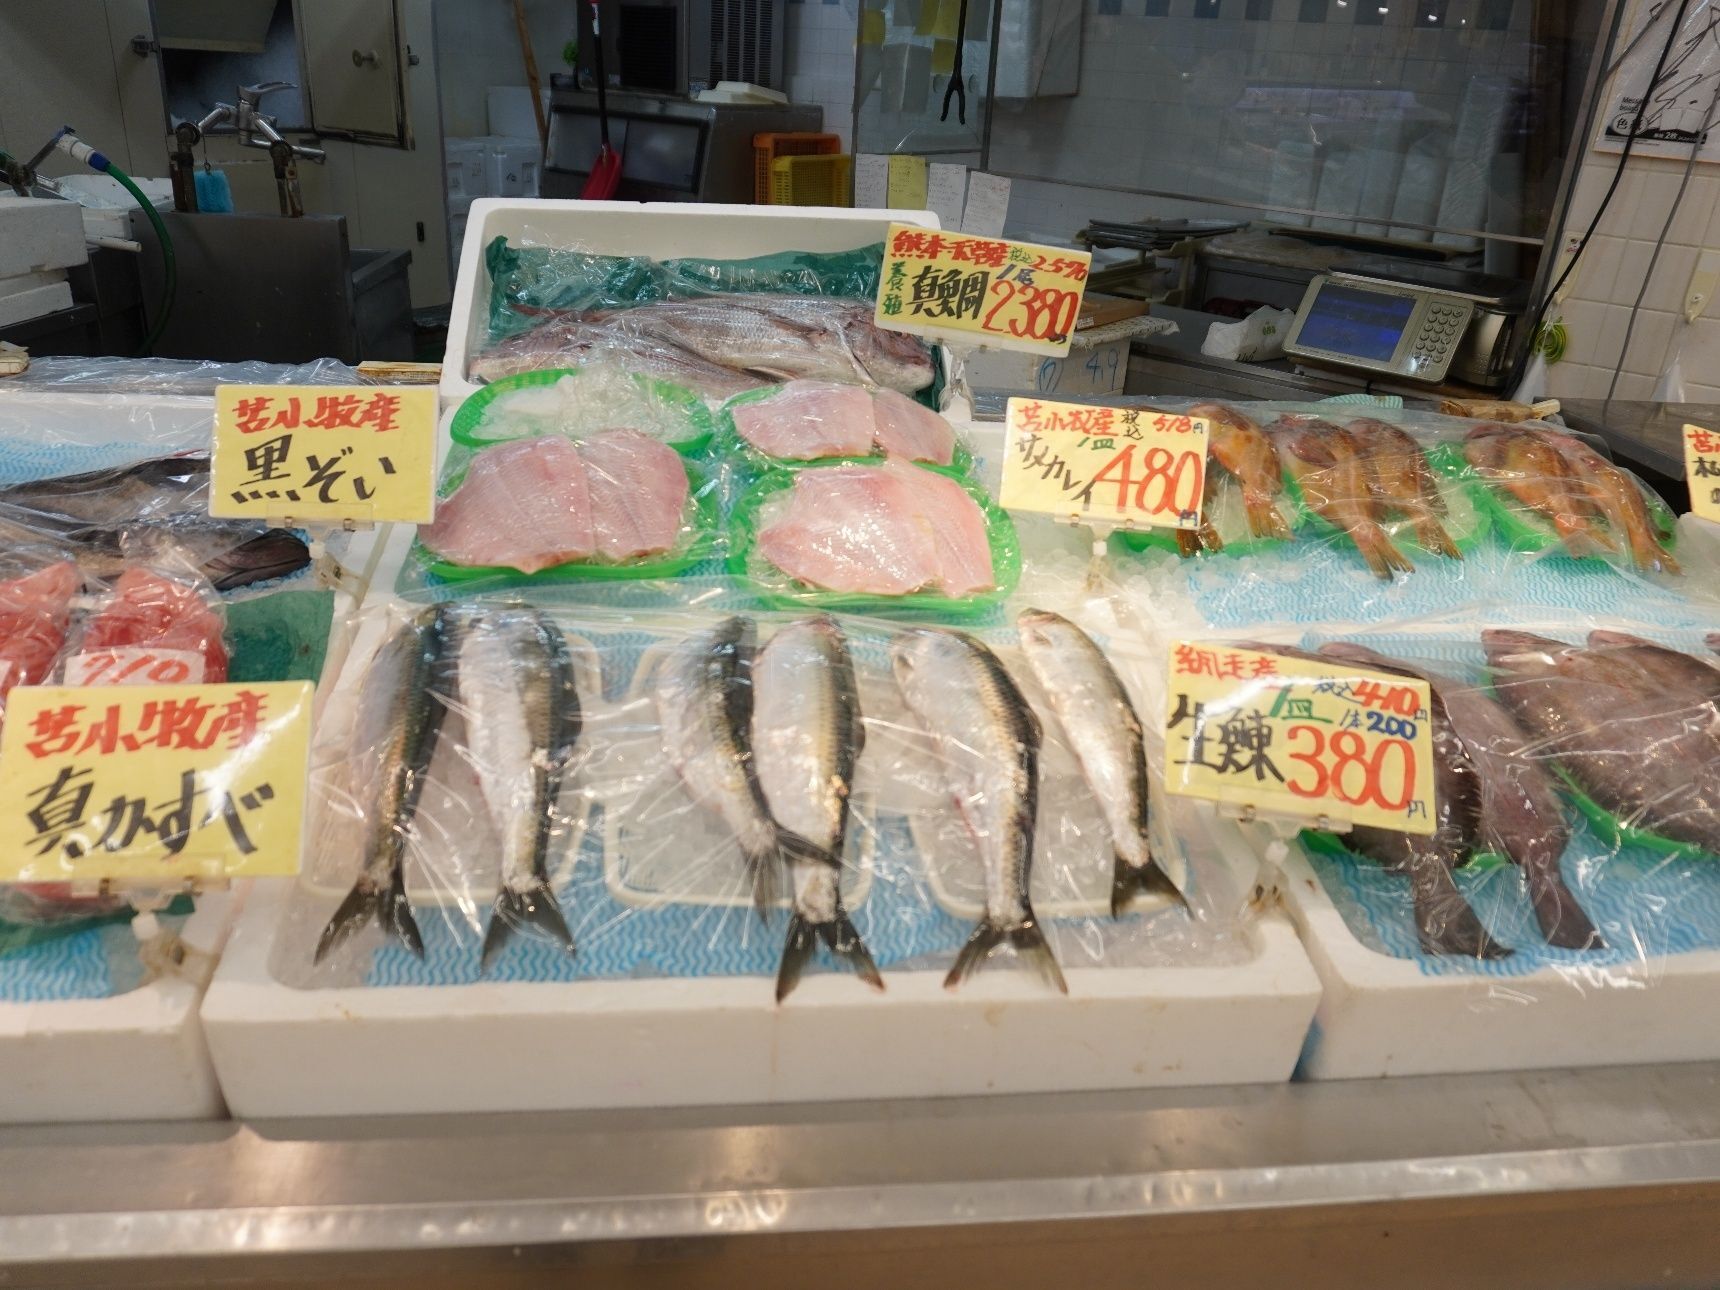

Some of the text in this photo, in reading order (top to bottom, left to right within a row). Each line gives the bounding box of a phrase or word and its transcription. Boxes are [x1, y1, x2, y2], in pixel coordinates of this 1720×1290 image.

[905, 265, 990, 320] 真鯛
[231, 392, 402, 434] 苫小牧産
[1015, 402, 1120, 437] 苫小牧産
[230, 433, 397, 504] 黒ぞい
[1014, 433, 1098, 512] サメカレイ
[24, 690, 270, 759] 苫小牧産
[24, 765, 275, 862] 真かすべ
